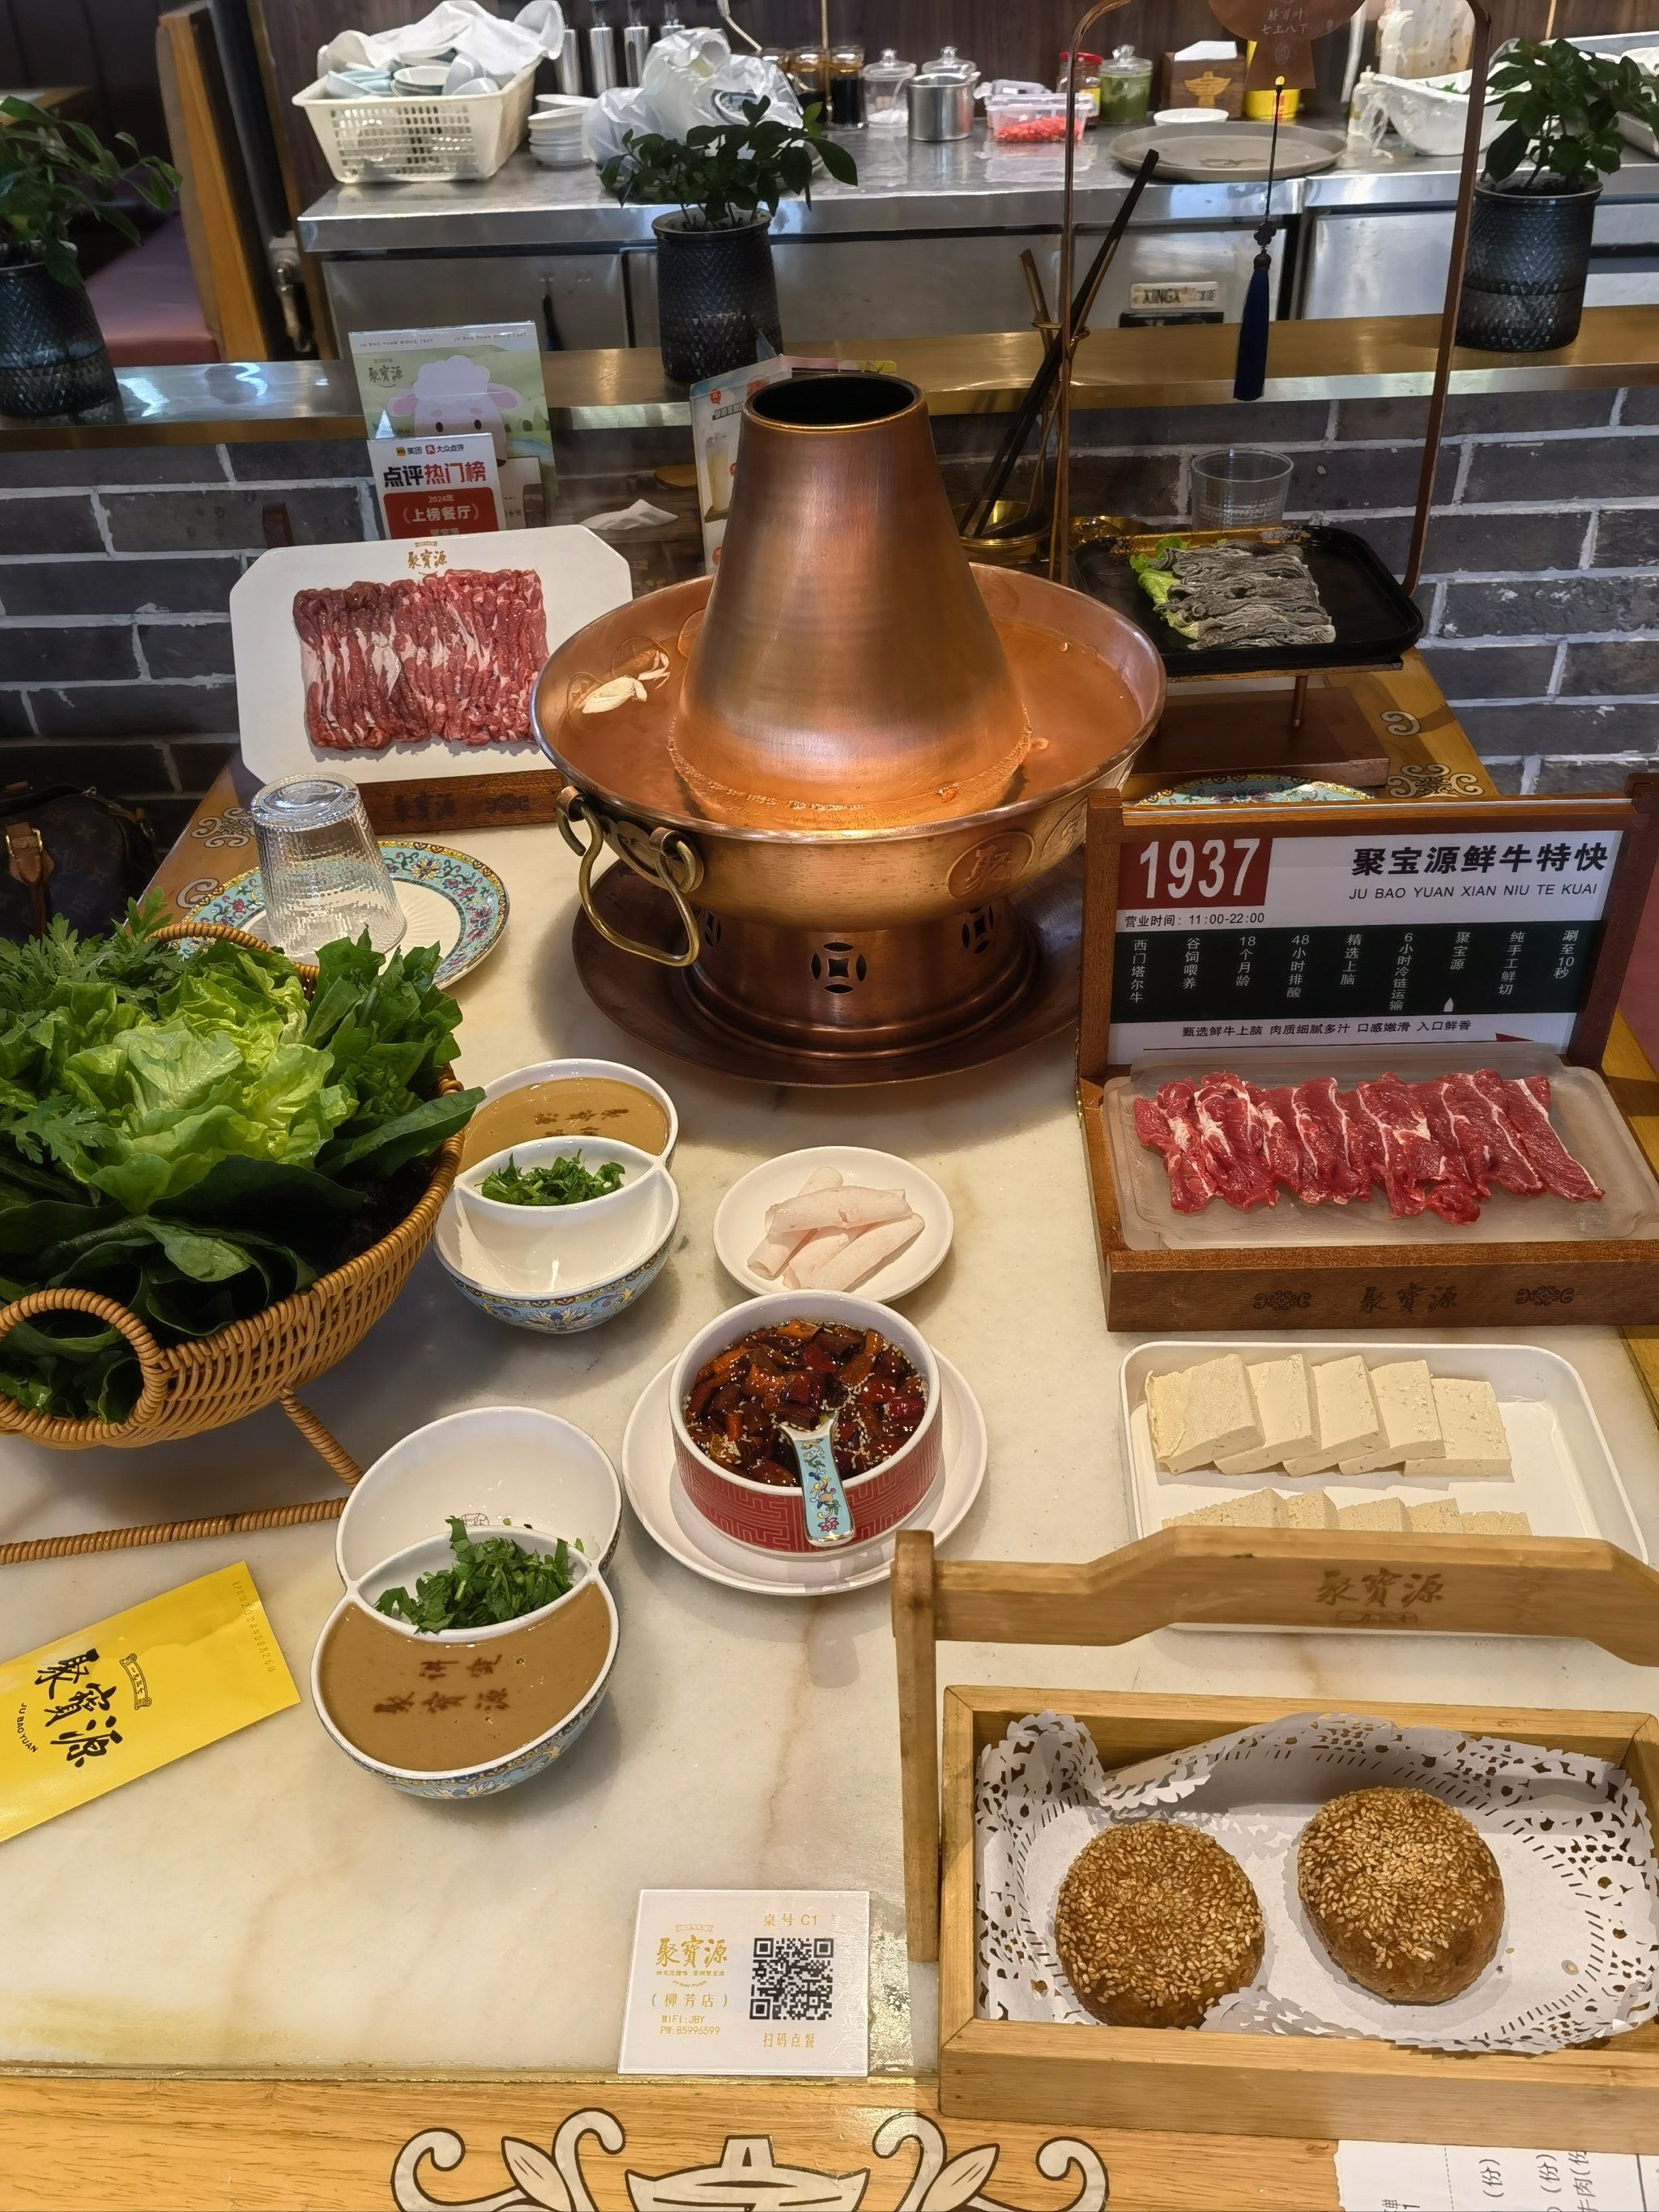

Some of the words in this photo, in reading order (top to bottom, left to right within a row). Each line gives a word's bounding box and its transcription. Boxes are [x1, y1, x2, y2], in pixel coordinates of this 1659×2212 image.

[382, 461, 486, 488] 点评热门榜
[428, 494, 454, 503] 2024年
[1139, 837, 1260, 899] 1937
[1351, 842, 1610, 876] 聚宝源鲜牛特快
[1349, 889, 1368, 900] JU
[1375, 888, 1406, 899] BAO
[1414, 886, 1455, 898] YUAN
[1461, 885, 1497, 897] XIAN
[1503, 884, 1530, 896] NIU
[1537, 884, 1555, 895] TE
[1562, 883, 1598, 895] KUAI
[1188, 913, 1265, 925] 11:00-22:00
[1182, 937, 1201, 990] 谷饲喂养
[1235, 936, 1256, 987] 18个月龄
[1286, 935, 1310, 999] 48小时排酸
[1339, 933, 1363, 986] 精选上脑
[1449, 931, 1471, 971] 聚宝源
[1498, 931, 1525, 995] 纯手工鲜切
[1553, 929, 1580, 979] 涮至10秒
[1129, 939, 1149, 1004] 西门塔尔牛
[1388, 932, 1414, 1012] 6小时冷链运输
[1182, 1025, 1264, 1038] 甄选鲜牛上脑
[1269, 1023, 1351, 1035] 肉质细腻多汁
[1357, 1021, 1411, 1034] 口感嫩滑
[1417, 1021, 1471, 1032] 入口鲜香
[16, 1715, 24, 1734] BAO
[19, 1703, 28, 1715] JU
[35, 1648, 123, 1767] 聚寶源
[19, 1733, 39, 1753] YUAN
[764, 1913, 794, 1927] 桌号
[800, 1914, 818, 1927] C1
[656, 1934, 727, 1968] 聚寶源
[763, 2032, 815, 2048] 扫码点餐
